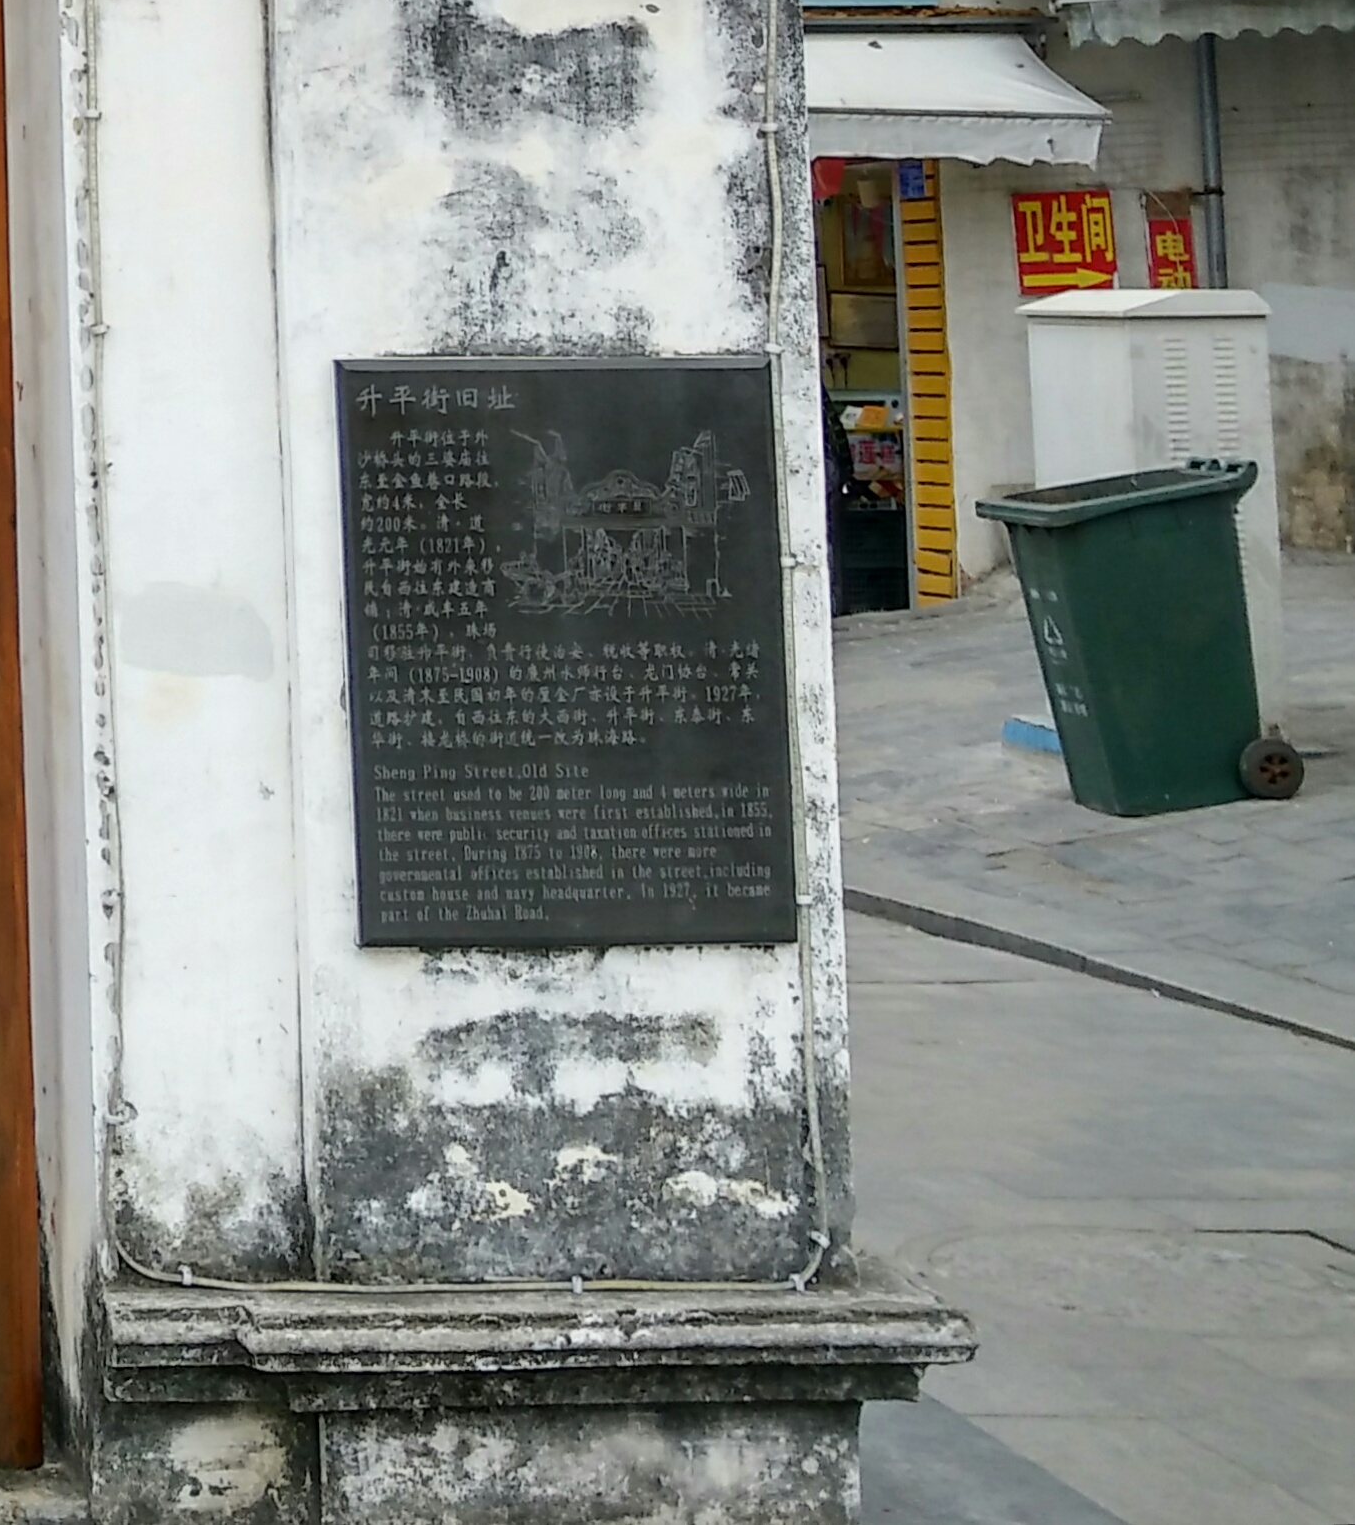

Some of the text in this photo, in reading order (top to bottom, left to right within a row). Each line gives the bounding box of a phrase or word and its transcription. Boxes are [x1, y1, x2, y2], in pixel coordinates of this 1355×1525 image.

[1018, 195, 1115, 264] 卫生间
[355, 383, 516, 418] 升平街旧址
[374, 764, 416, 782] Sheng
[423, 764, 456, 780] Ping
[555, 764, 589, 778] Site
[374, 786, 396, 802] The
[403, 788, 445, 802] street
[454, 787, 482, 802] used
[489, 788, 502, 801] to
[509, 785, 522, 801] be
[529, 785, 550, 801] 200
[600, 784, 626, 802] long
[632, 784, 654, 799] and
[721, 783, 749, 798] wide
[756, 782, 770, 798] in
[410, 807, 439, 822] when
[445, 807, 502, 822] business
[509, 809, 551, 821] venues
[558, 808, 586, 820] were
[593, 804, 628, 820] first
[377, 829, 411, 842] there
[417, 830, 443, 842] were
[497, 826, 549, 842] security
[557, 825, 577, 841] and
[584, 825, 637, 840] taxation
[642, 824, 687, 839] offices
[694, 822, 754, 839] stationed
[759, 823, 772, 837] in
[379, 846, 399, 862] the
[464, 845, 507, 863] During
[549, 847, 563, 859] to
[611, 844, 646, 859] there
[653, 846, 681, 859] were
[688, 846, 717, 859] more
[379, 865, 463, 885] governmental
[470, 865, 519, 881] offices
[525, 864, 604, 881] established
[611, 867, 624, 879] in
[632, 865, 652, 879] the
[379, 887, 425, 902] custom
[432, 885, 469, 901] house
[477, 885, 498, 900] and
[506, 888, 534, 905] navy
[641, 883, 655, 899] In
[706, 882, 718, 897] it
[727, 882, 771, 897] became
[381, 907, 409, 923] part
[417, 905, 430, 922] of
[438, 905, 459, 921] the
[465, 904, 507, 921] Zhuhai
